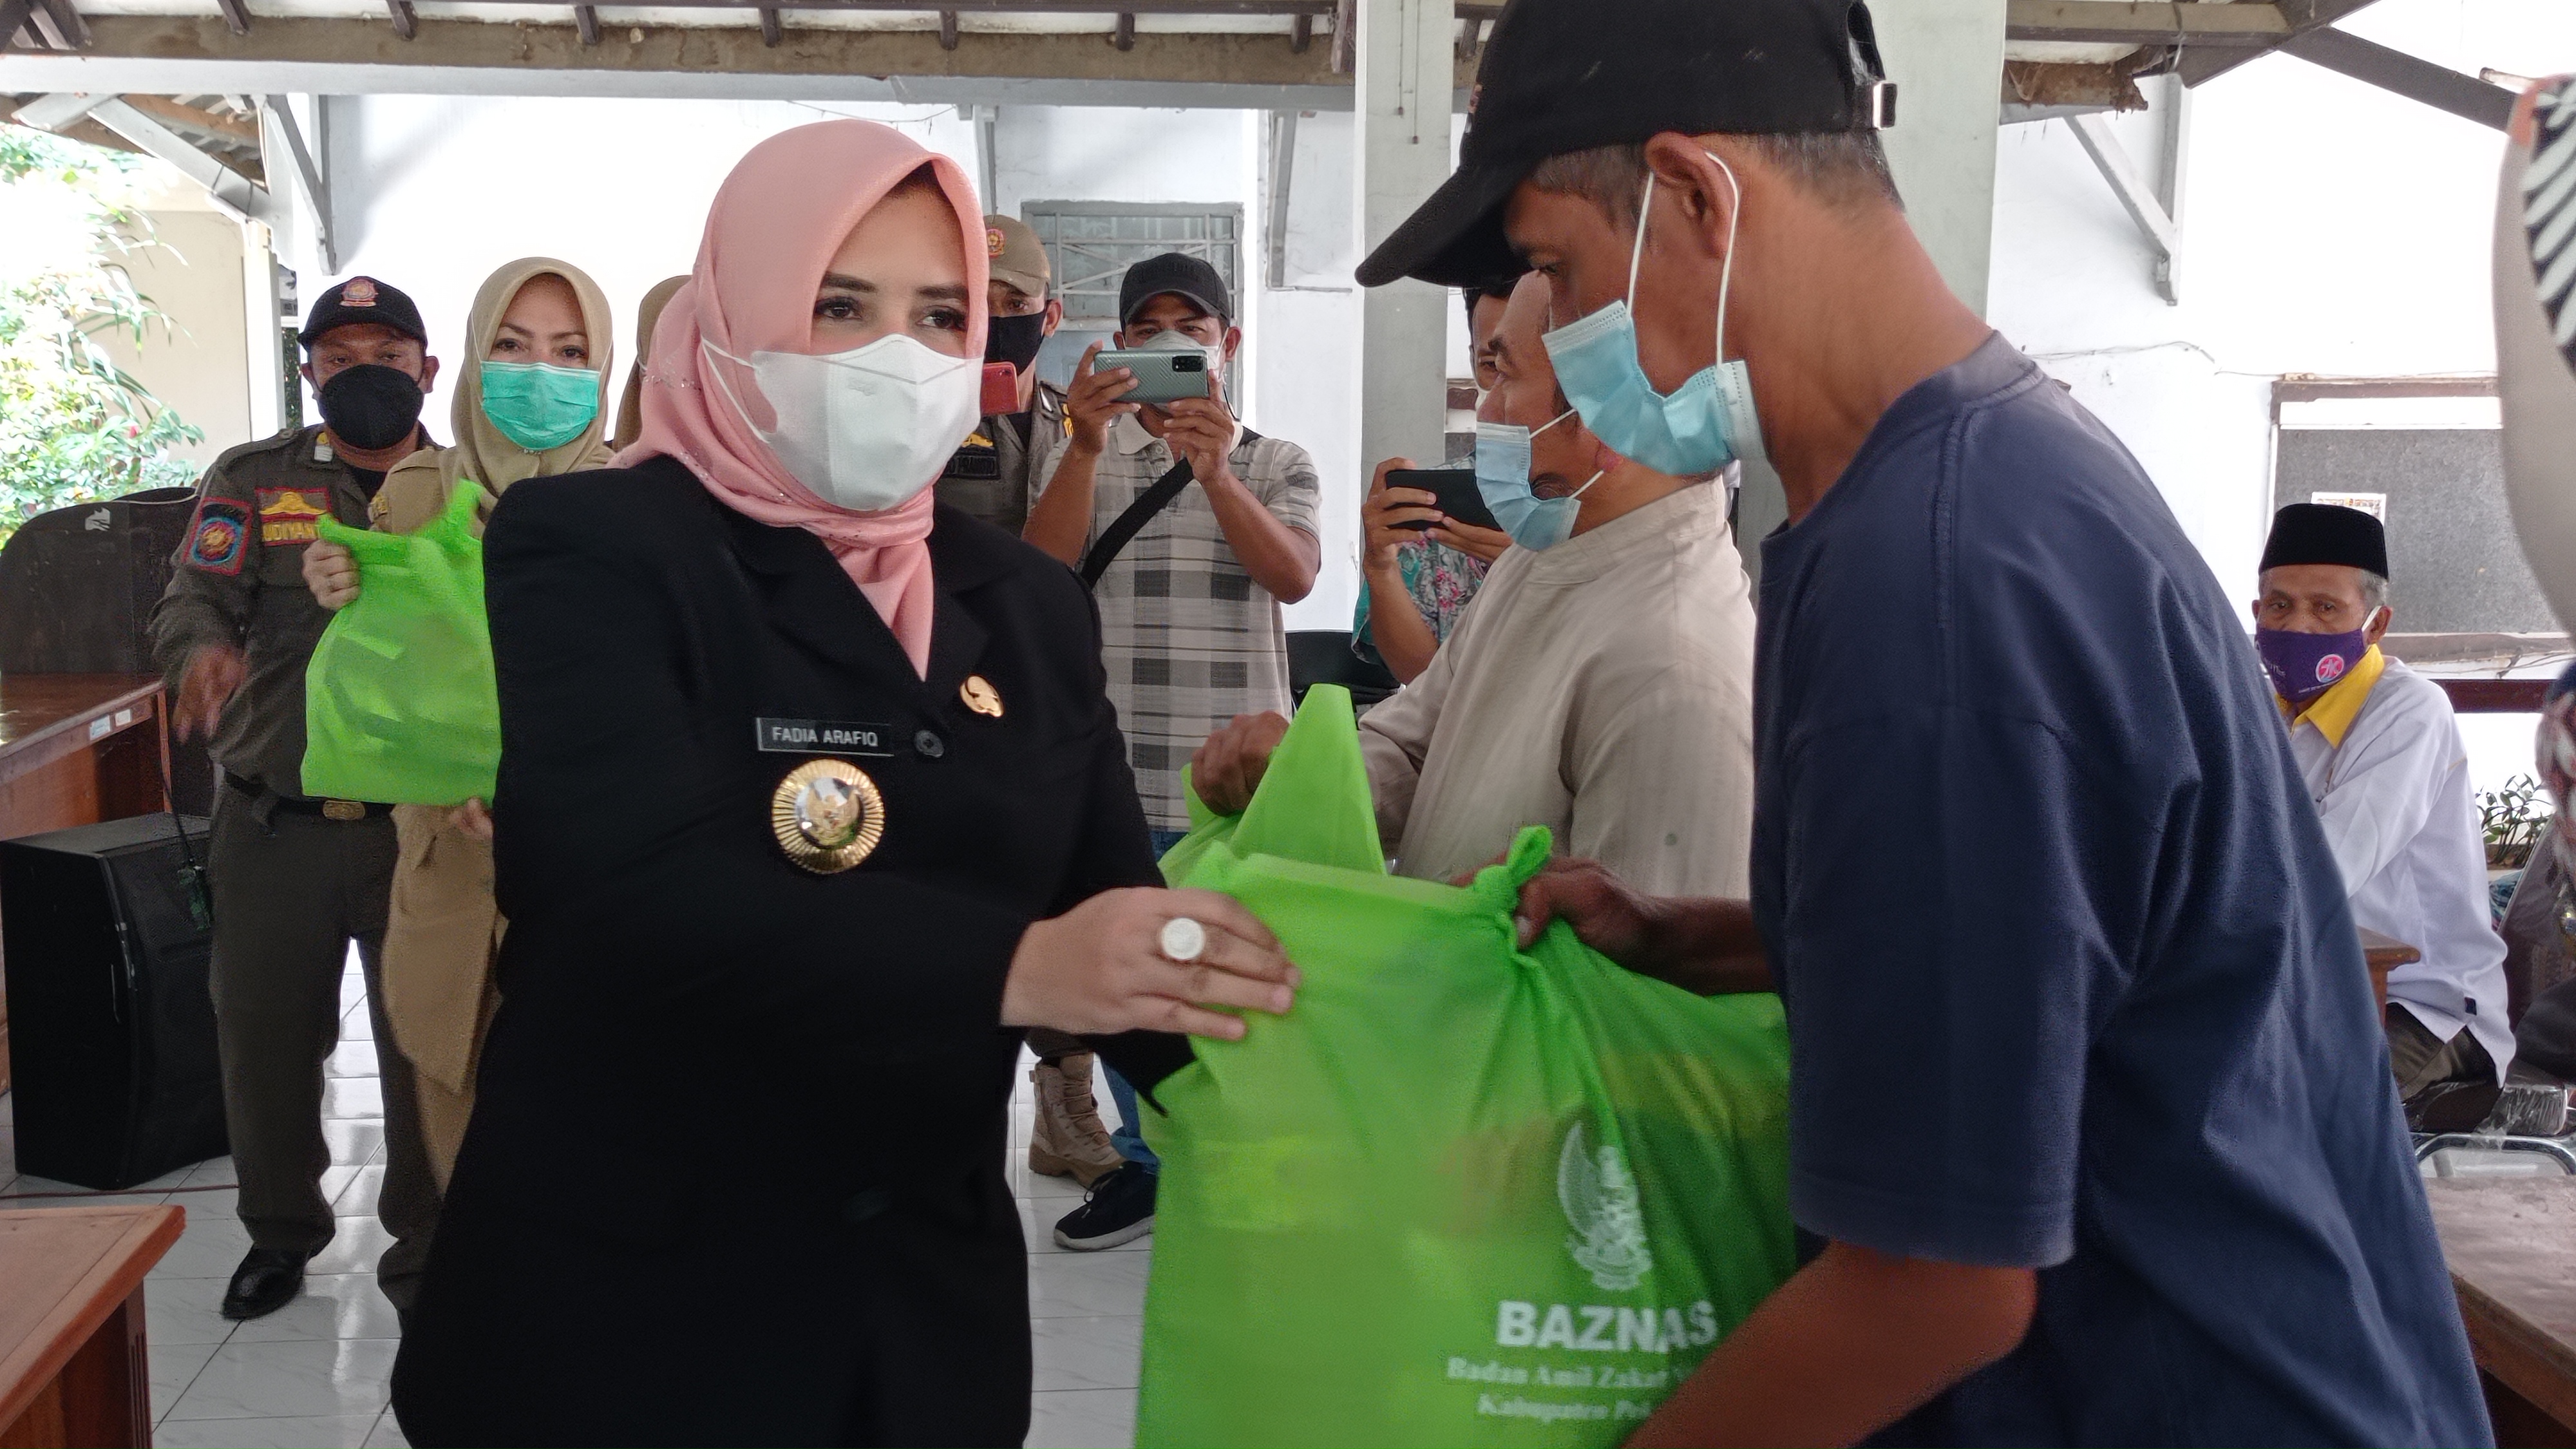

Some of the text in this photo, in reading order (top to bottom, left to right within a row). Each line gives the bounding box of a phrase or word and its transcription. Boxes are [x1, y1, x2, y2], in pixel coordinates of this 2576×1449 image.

[772, 726, 878, 747] FADIA ARAFIQ
[1496, 1300, 1719, 1353] BAZNAS
[1447, 1357, 1529, 1384] Badan
[1537, 1366, 1593, 1387] Amil
[1477, 1393, 1609, 1423] Kabupaten
